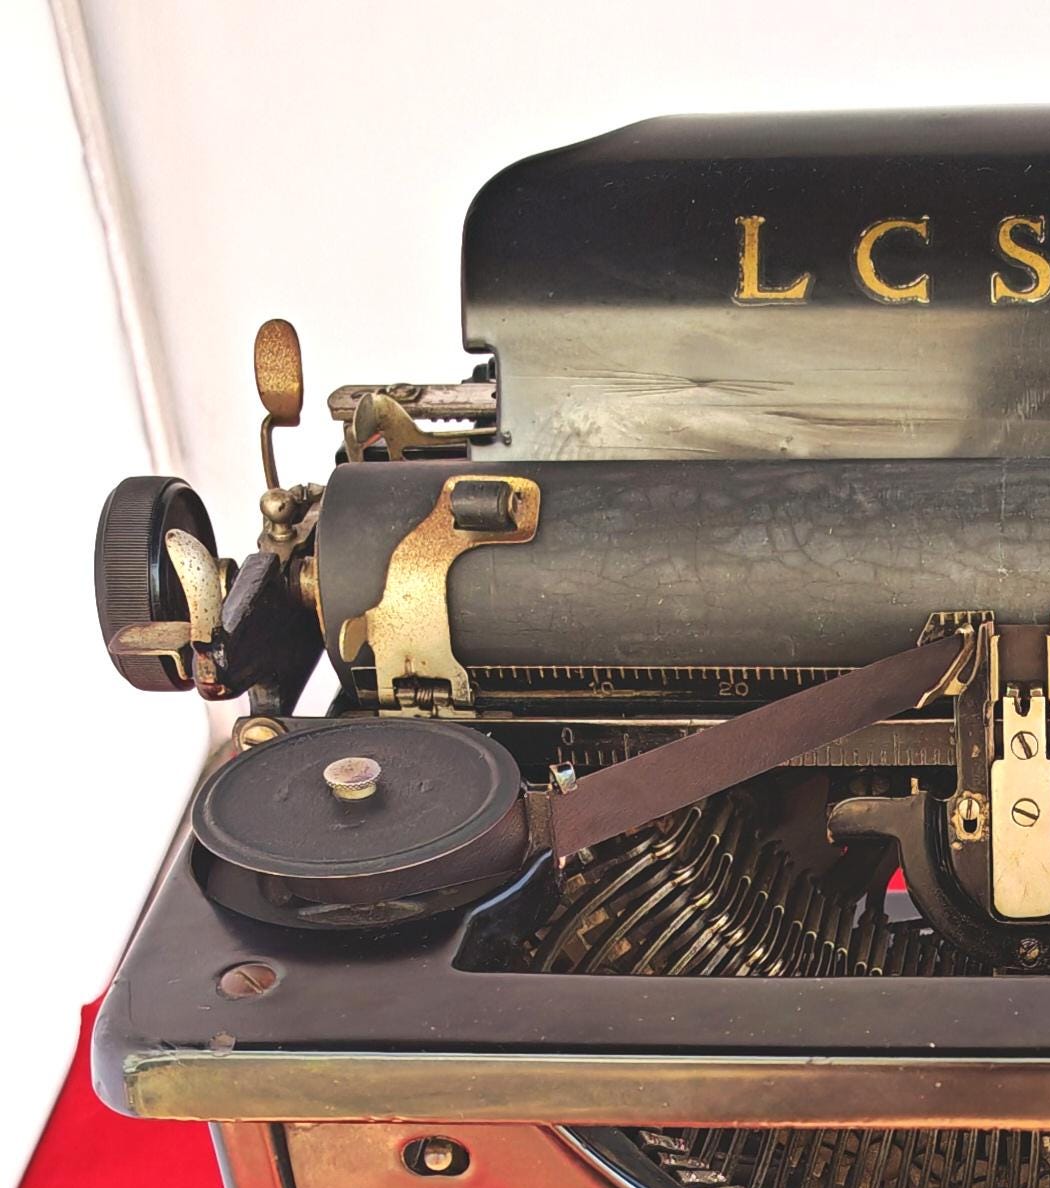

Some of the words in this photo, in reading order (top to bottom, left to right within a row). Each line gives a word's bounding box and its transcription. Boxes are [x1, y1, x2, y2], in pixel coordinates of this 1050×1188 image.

[733, 214, 813, 305] L
[853, 213, 931, 304] C
[718, 681, 749, 697] 20
